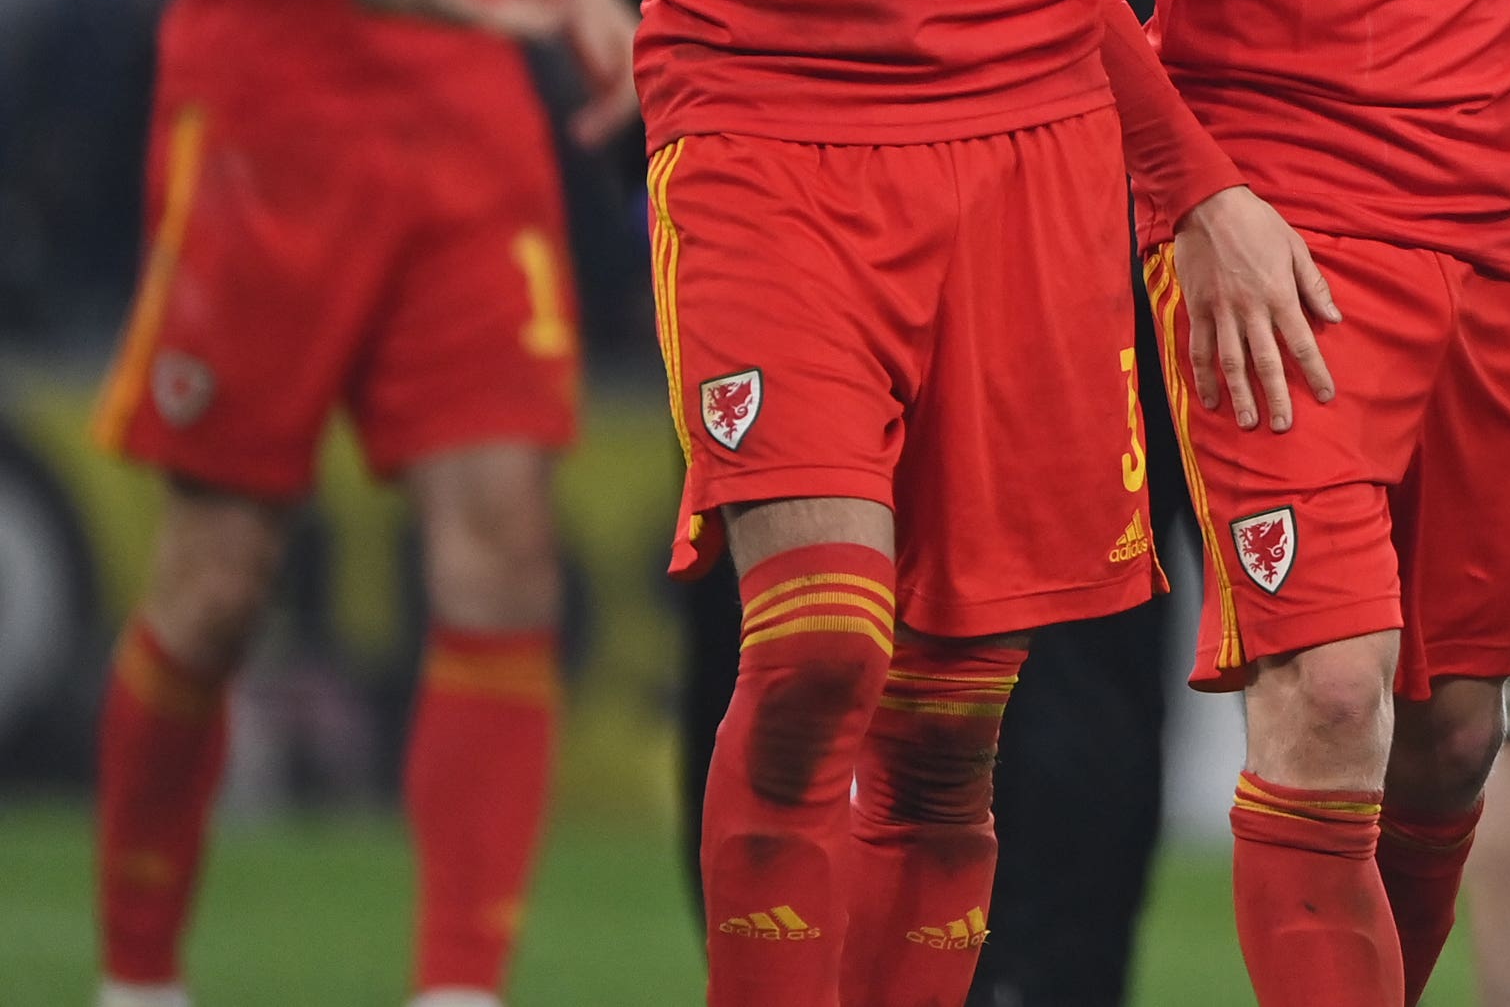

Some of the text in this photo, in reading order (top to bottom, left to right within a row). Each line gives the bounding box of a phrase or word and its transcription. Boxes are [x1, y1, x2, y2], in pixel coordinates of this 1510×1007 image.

[1119, 346, 1146, 492] 3
[1109, 538, 1148, 562] adidas
[719, 923, 821, 941] adidas
